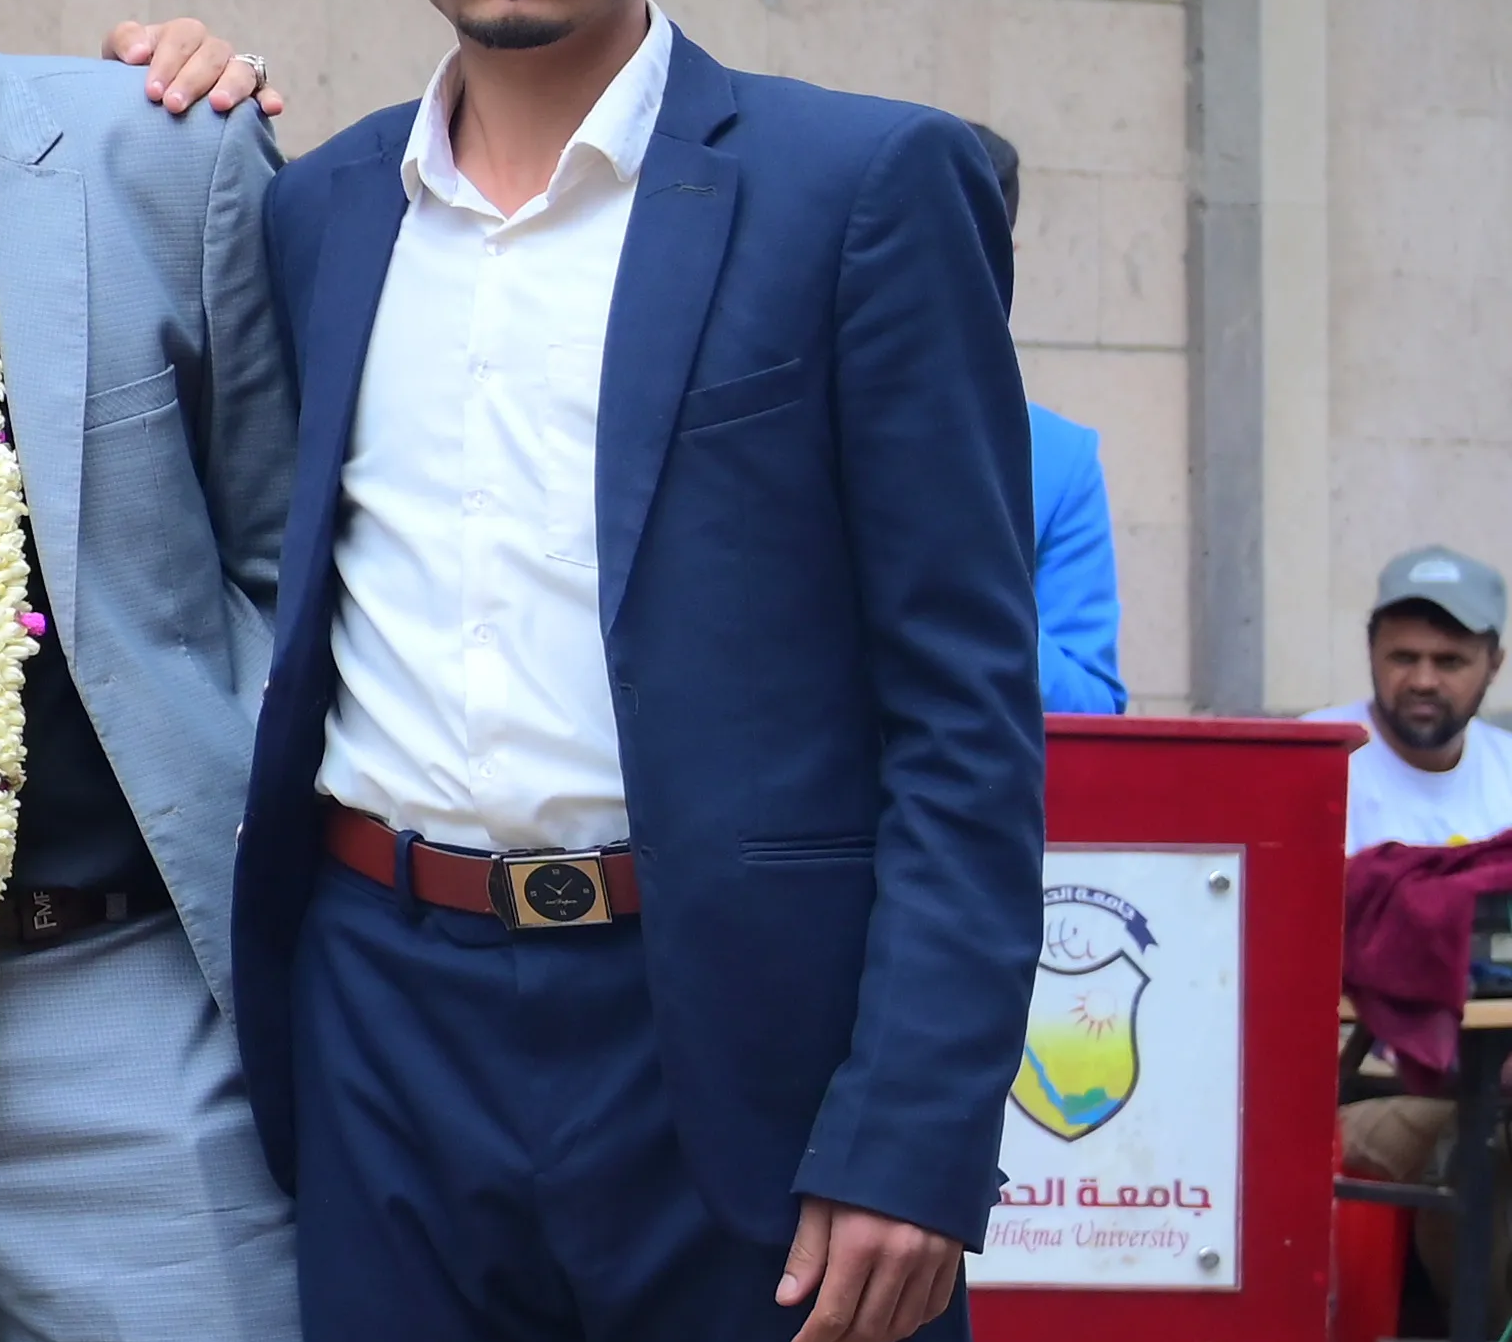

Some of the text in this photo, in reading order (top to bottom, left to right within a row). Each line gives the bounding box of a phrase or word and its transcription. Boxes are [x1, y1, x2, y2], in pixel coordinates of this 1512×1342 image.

[1000, 1177, 1212, 1217] جامعة الح
[1071, 1220, 1190, 1258] University
